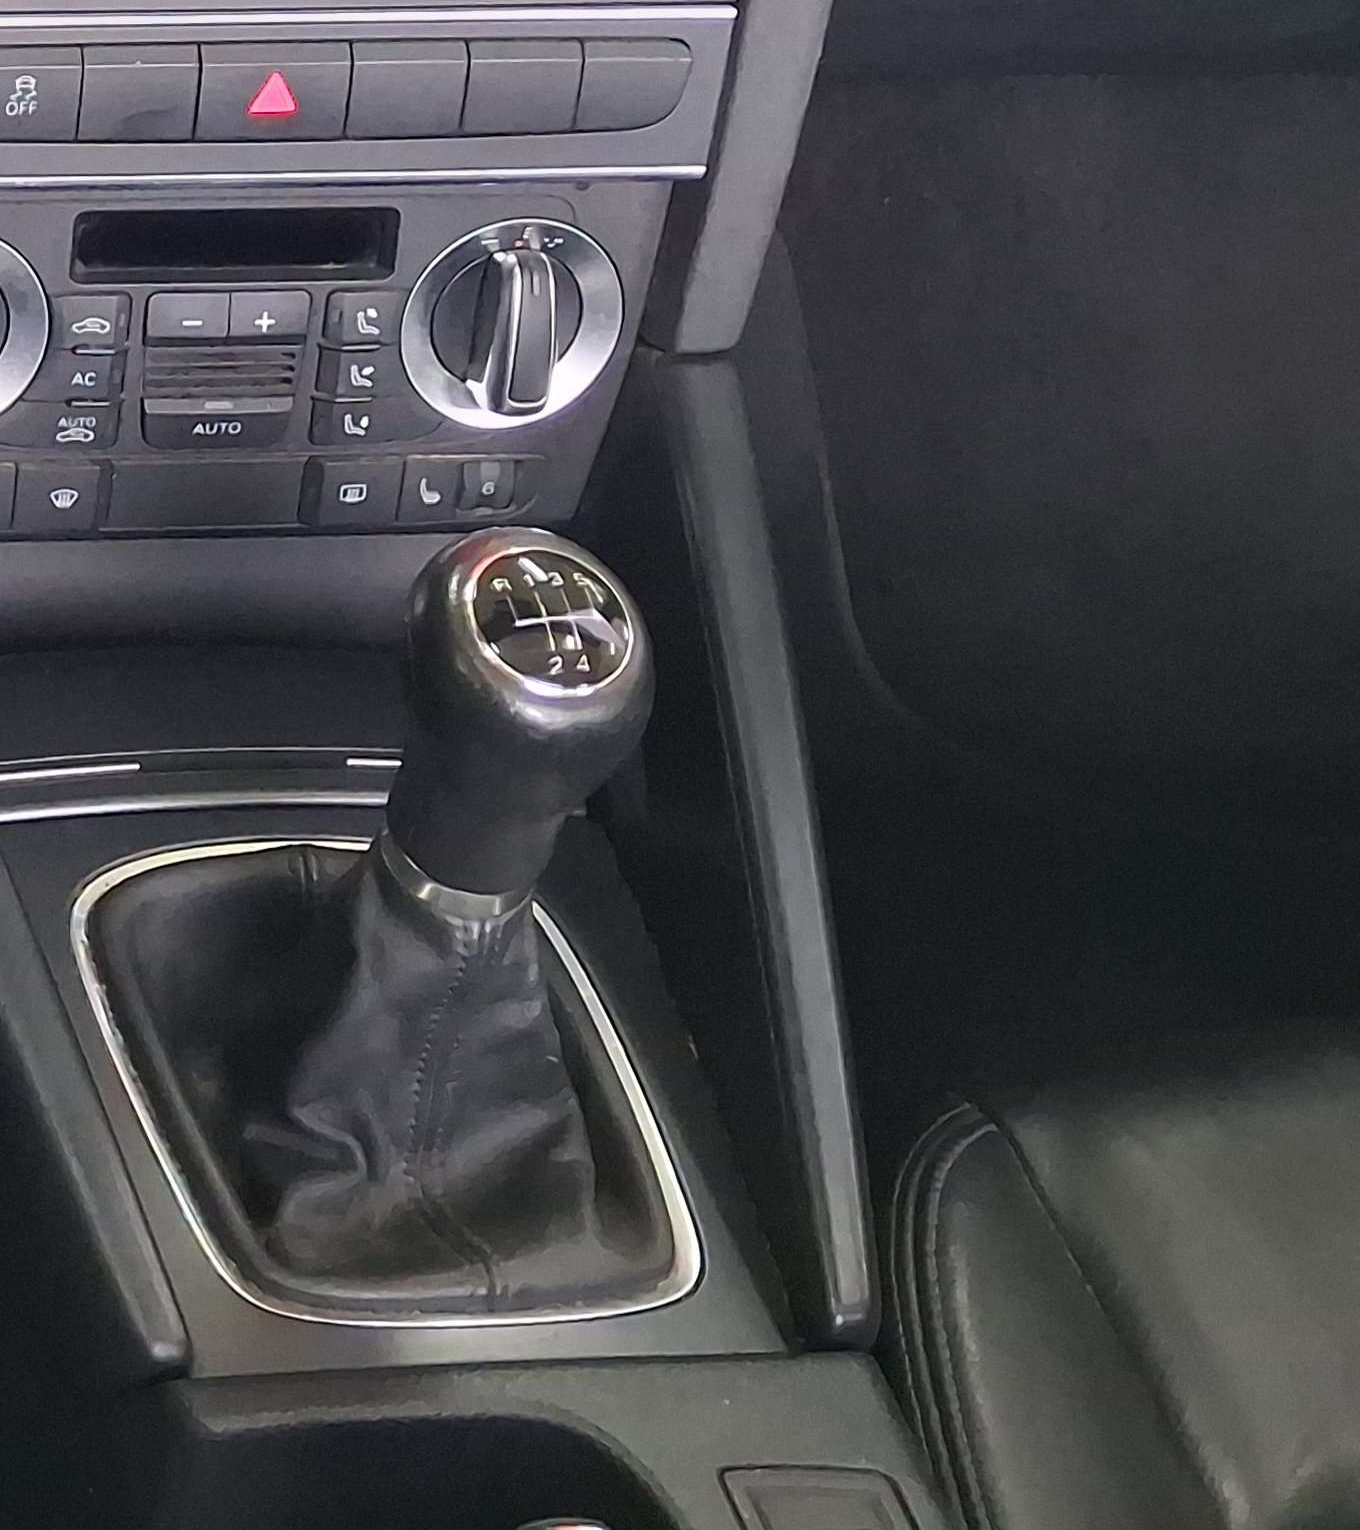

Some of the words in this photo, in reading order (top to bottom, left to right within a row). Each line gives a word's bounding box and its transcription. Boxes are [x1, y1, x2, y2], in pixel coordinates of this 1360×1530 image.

[5, 100, 38, 116] OFF
[71, 372, 97, 387] AC
[57, 416, 97, 429] AUTO
[191, 421, 242, 436] AUTO
